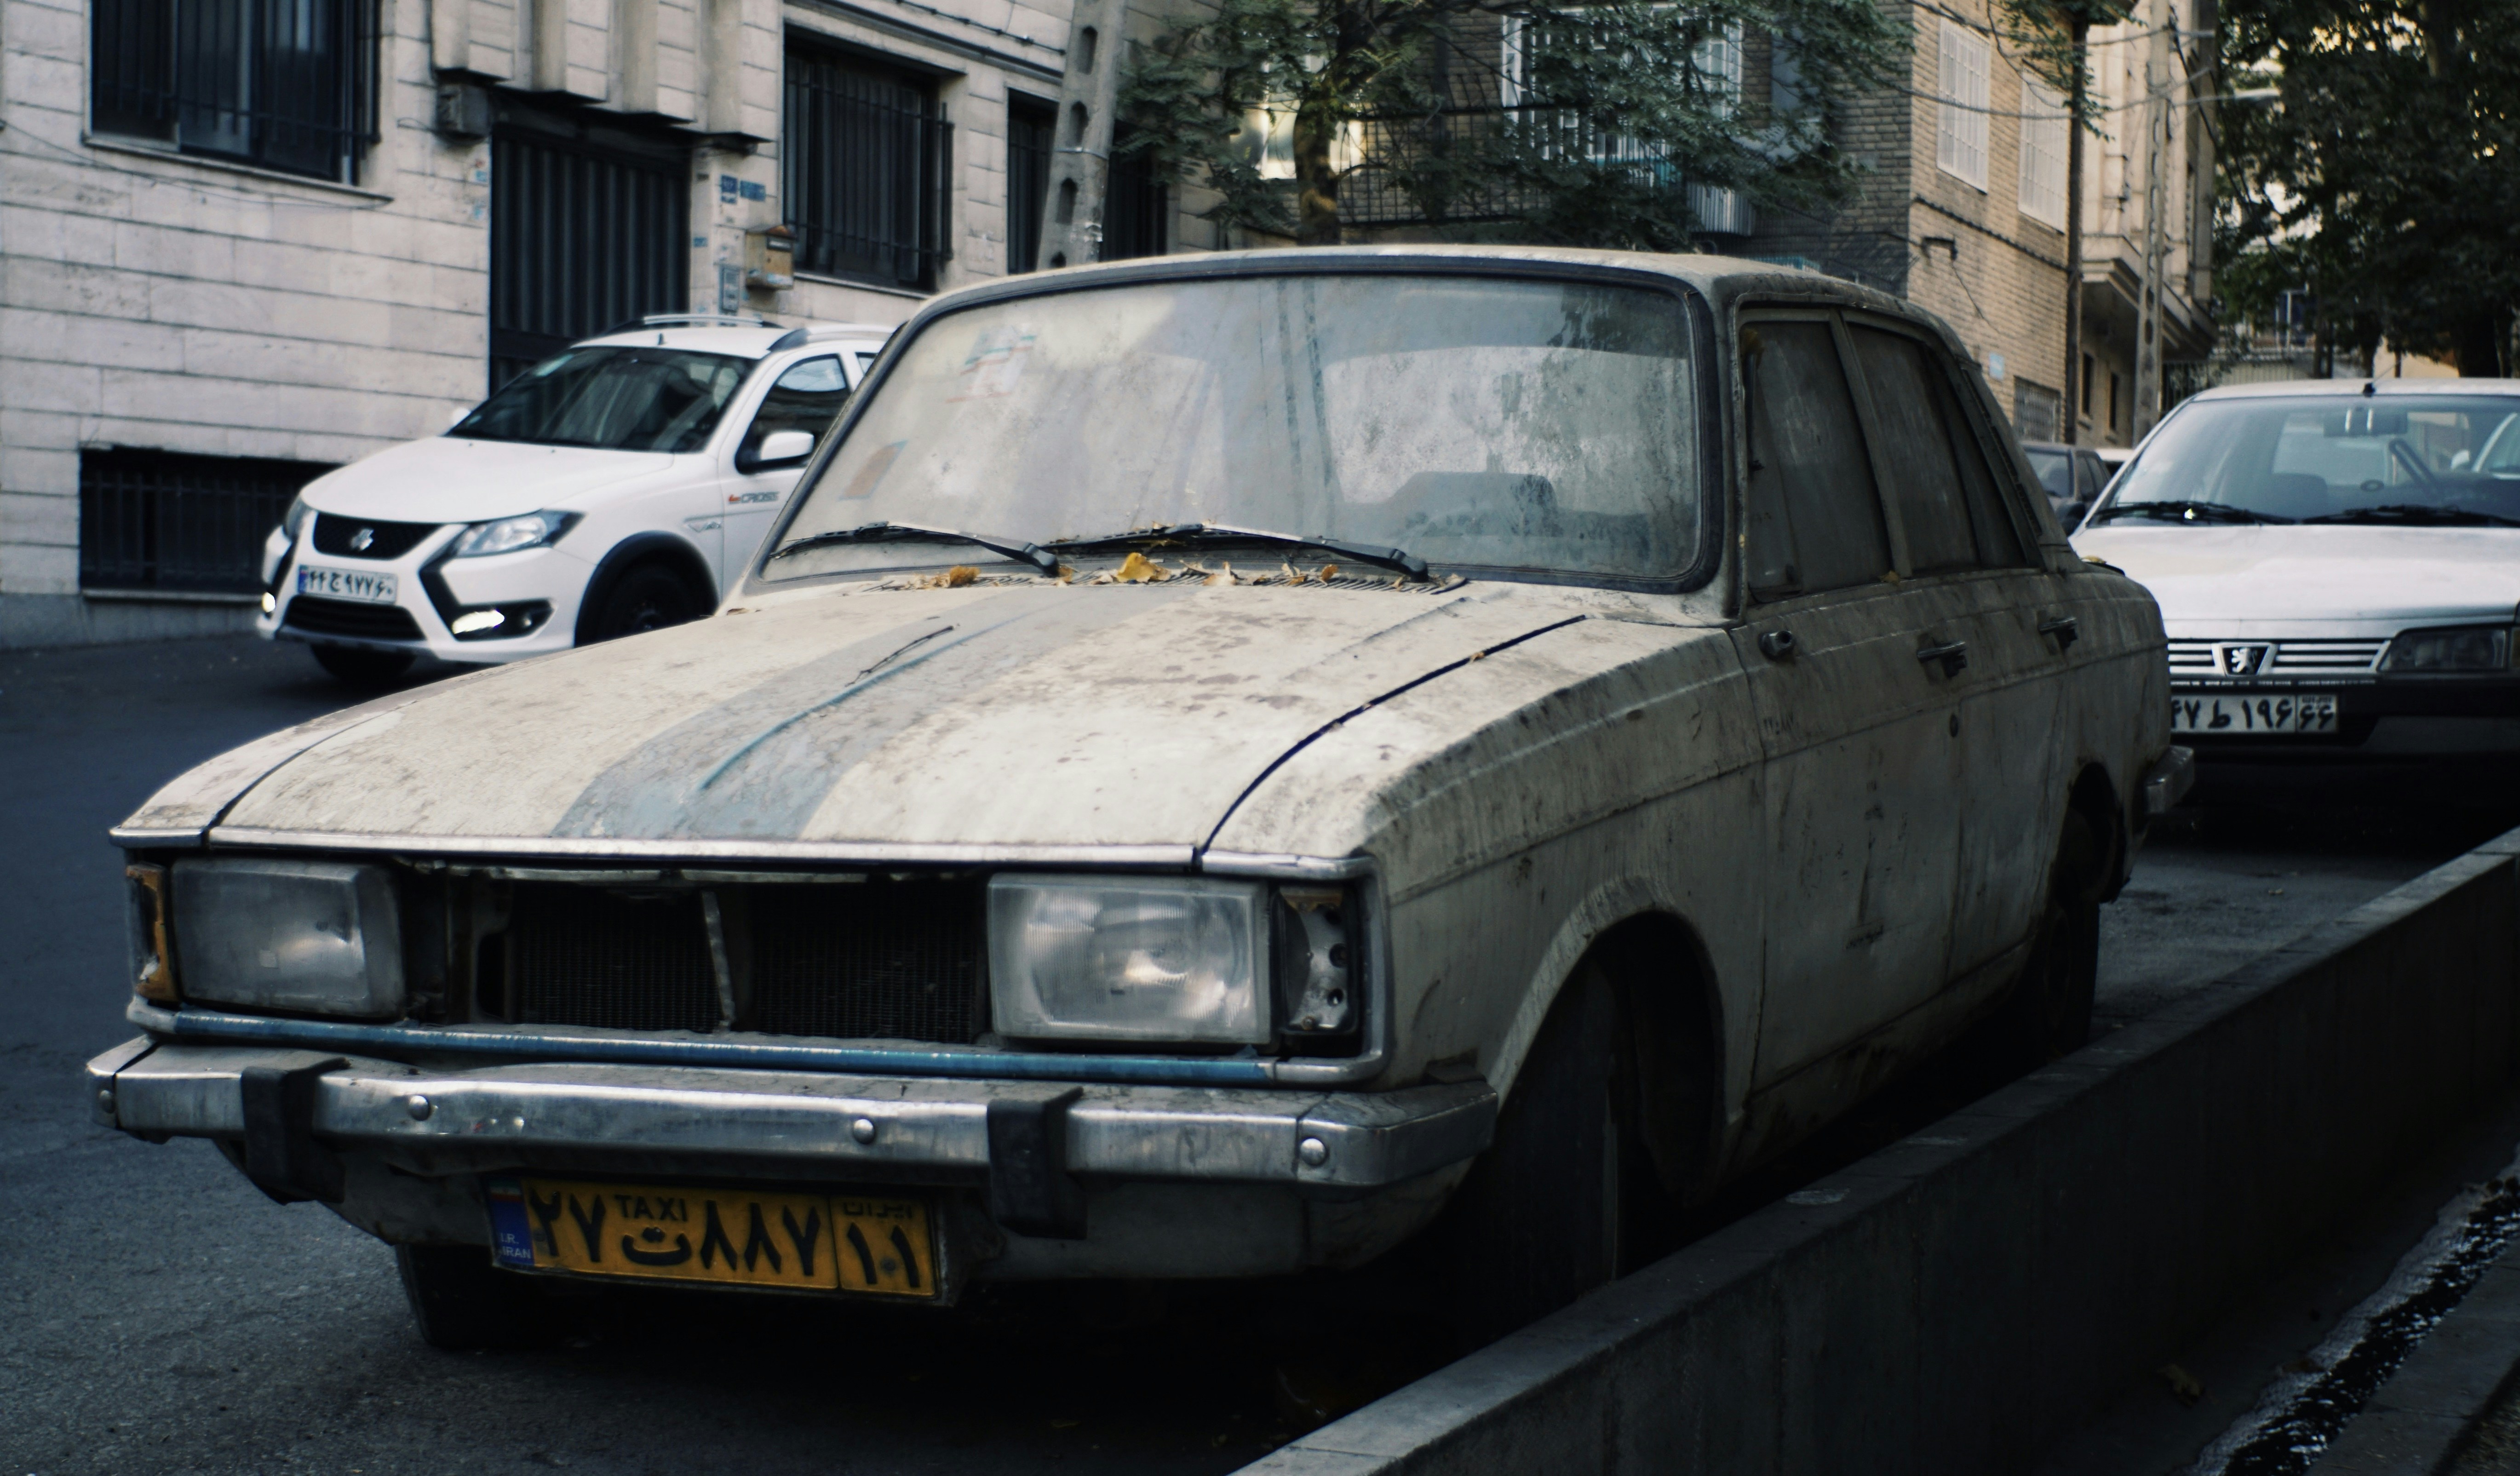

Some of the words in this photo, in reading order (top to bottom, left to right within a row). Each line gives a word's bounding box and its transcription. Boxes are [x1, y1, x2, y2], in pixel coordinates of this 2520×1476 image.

[2208, 699, 2232, 729] ط
[2241, 698, 2293, 729] ۱۹۶
[2300, 704, 2334, 730] ۶۶
[614, 1194, 689, 1222] TAXI
[530, 1187, 606, 1262] ۲۷
[622, 1226, 693, 1265] ت
[700, 1200, 821, 1276] ۸۸۷
[847, 1222, 920, 1288] ۱۱
[502, 1247, 532, 1260] IRAN
